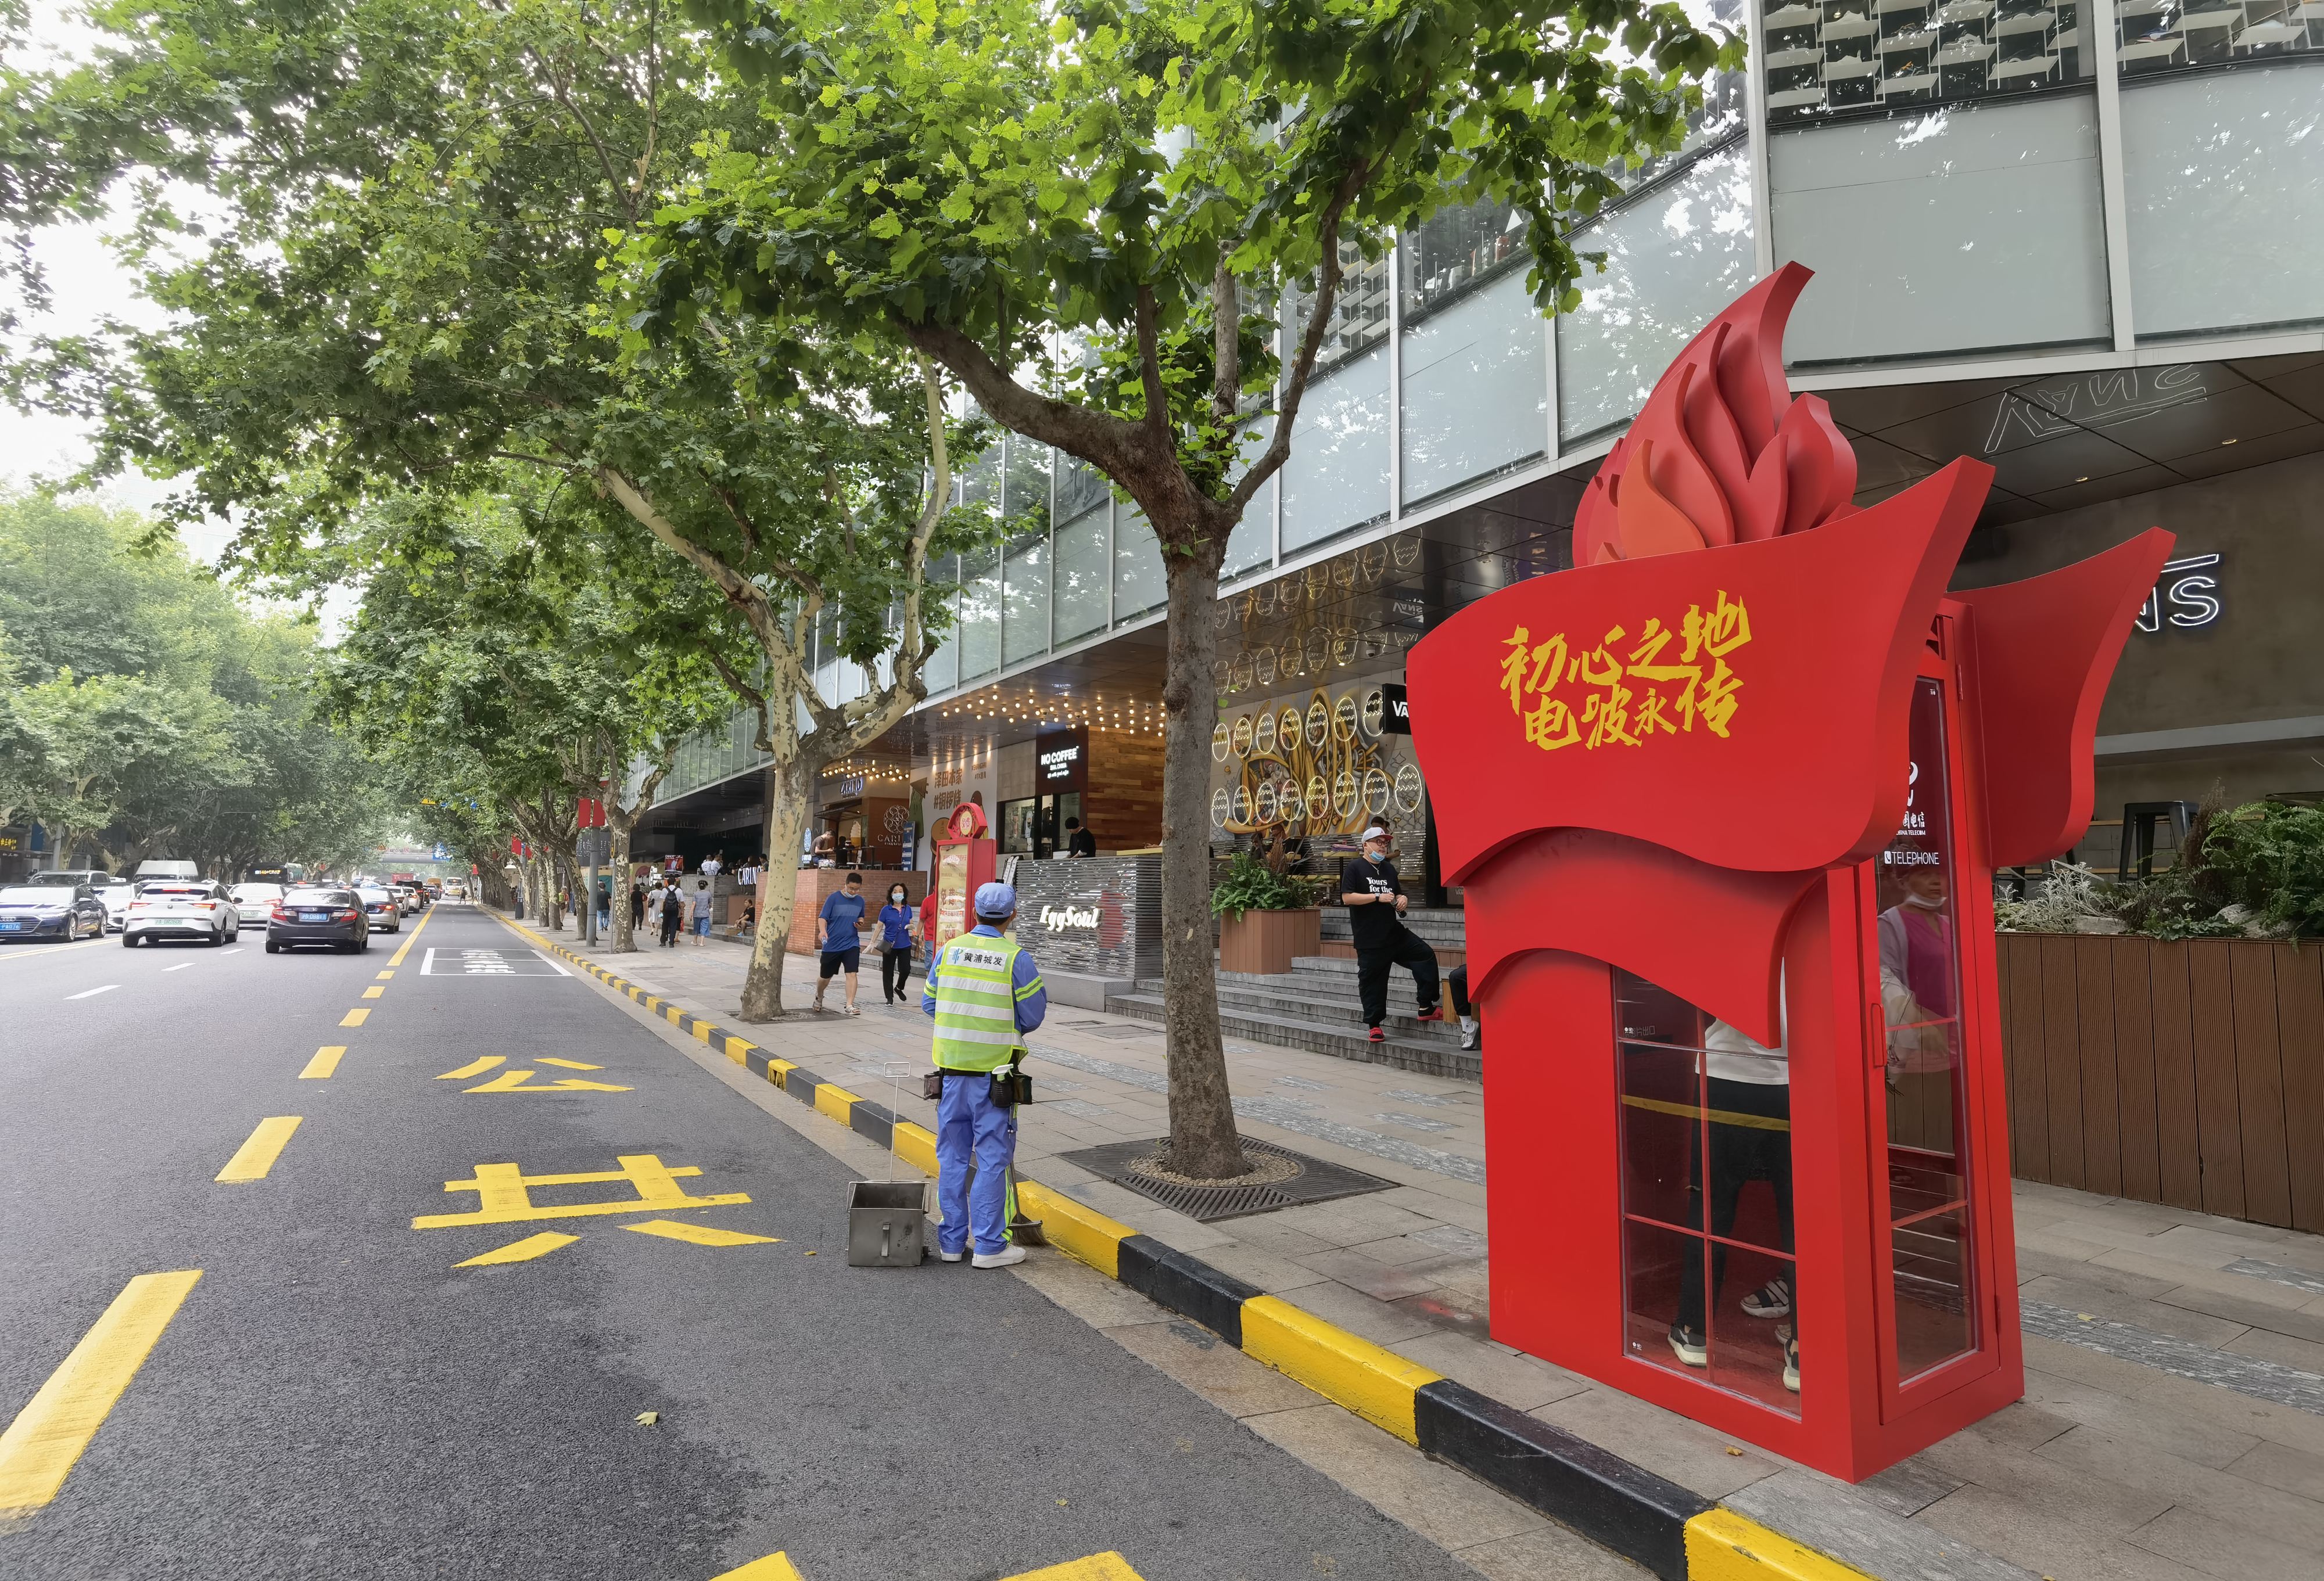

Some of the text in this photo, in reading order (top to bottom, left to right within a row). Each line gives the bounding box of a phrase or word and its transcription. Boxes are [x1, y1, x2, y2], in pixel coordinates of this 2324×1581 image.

[1501, 590, 1752, 716] 初心之地
[1041, 748, 1077, 765] NO COFFEE
[935, 768, 963, 788] 泽田本家
[934, 789, 962, 810] #铜锣烧
[1892, 851, 1939, 865] TELEPHONE
[1366, 877, 1387, 885] Yours
[1039, 906, 1099, 932] EggSoul
[963, 953, 1003, 966] 黄浦城发
